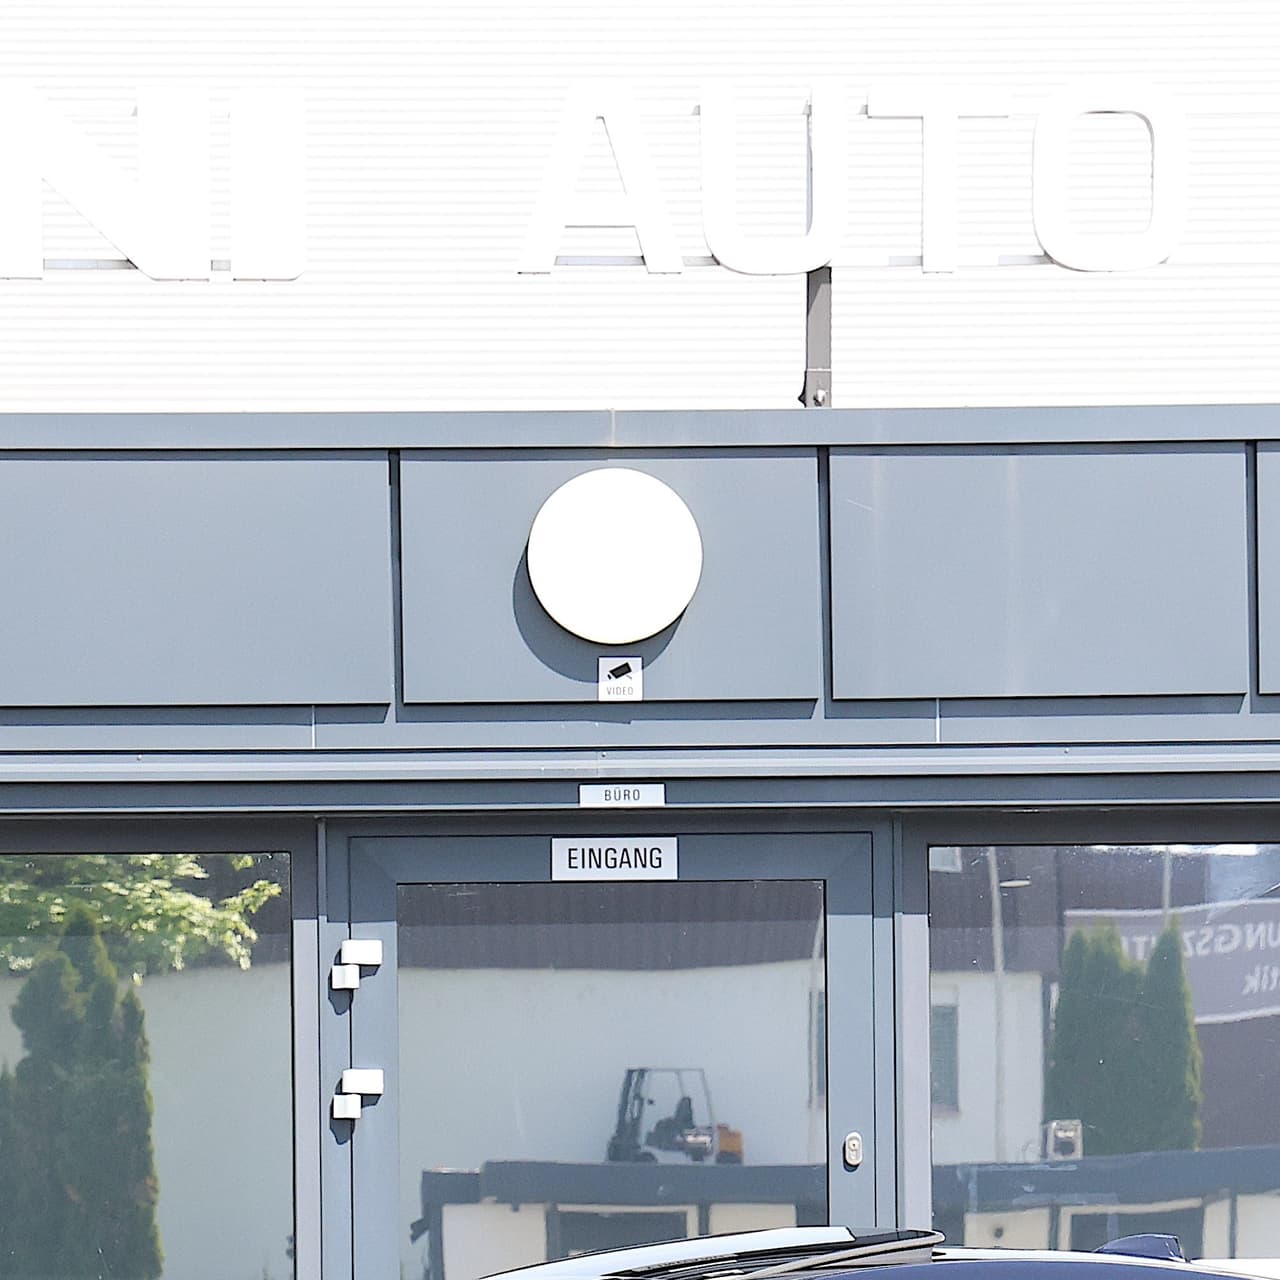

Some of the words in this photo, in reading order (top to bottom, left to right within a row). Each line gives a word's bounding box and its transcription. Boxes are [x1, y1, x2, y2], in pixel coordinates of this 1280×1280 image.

[516, 76, 1187, 277] AUTO
[606, 685, 634, 696] VIDEO
[603, 787, 641, 801] BÜRO
[568, 847, 663, 869] EINGANG
